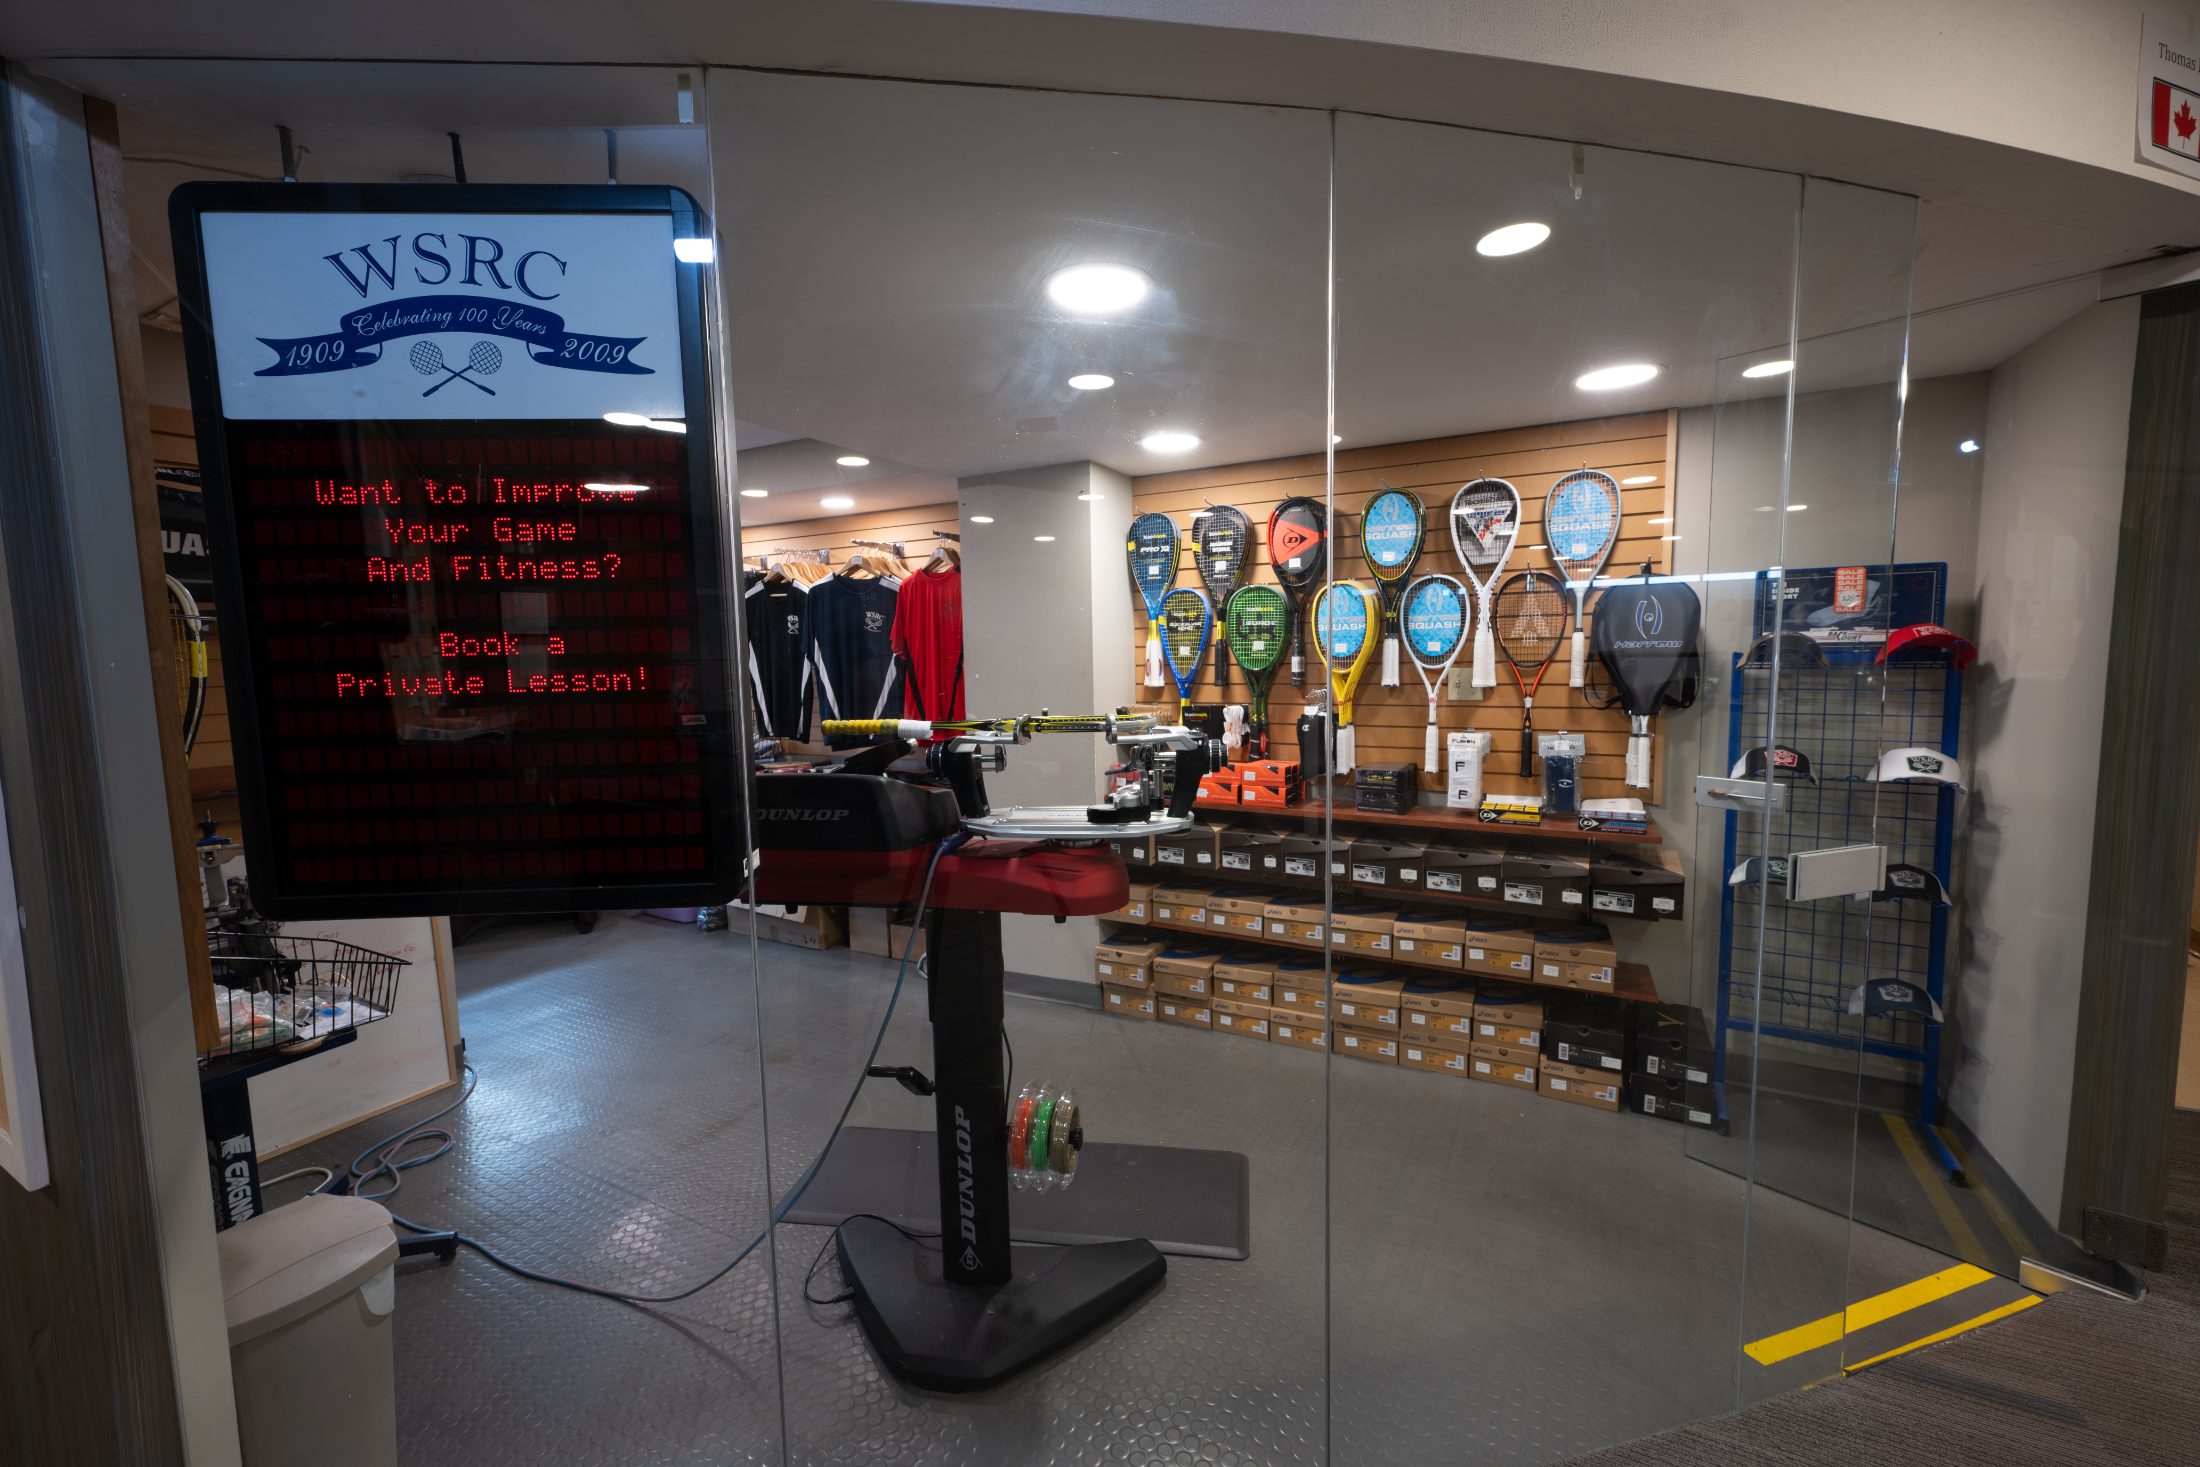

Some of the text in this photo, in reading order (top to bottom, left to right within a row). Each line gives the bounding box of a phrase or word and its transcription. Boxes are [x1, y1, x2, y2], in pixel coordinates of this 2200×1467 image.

[2158, 42, 2196, 71] Thomas
[323, 233, 567, 300] WSRC
[352, 306, 547, 336] Celebrating 100 Years
[286, 340, 345, 367] 1909
[559, 338, 628, 365] 2009
[316, 479, 637, 504] Want to Improve
[161, 530, 209, 556] UA
[385, 518, 576, 543] Your Game
[368, 554, 621, 582] And Fitness?
[440, 632, 565, 656] Book a
[1613, 640, 1684, 648] Harrow
[337, 666, 645, 697] Private Lesson!
[1910, 755, 1941, 764] WSRC
[757, 808, 849, 821] DUNLOP
[955, 1104, 976, 1245] DUNLOP
[225, 1160, 255, 1223] EAGNA
